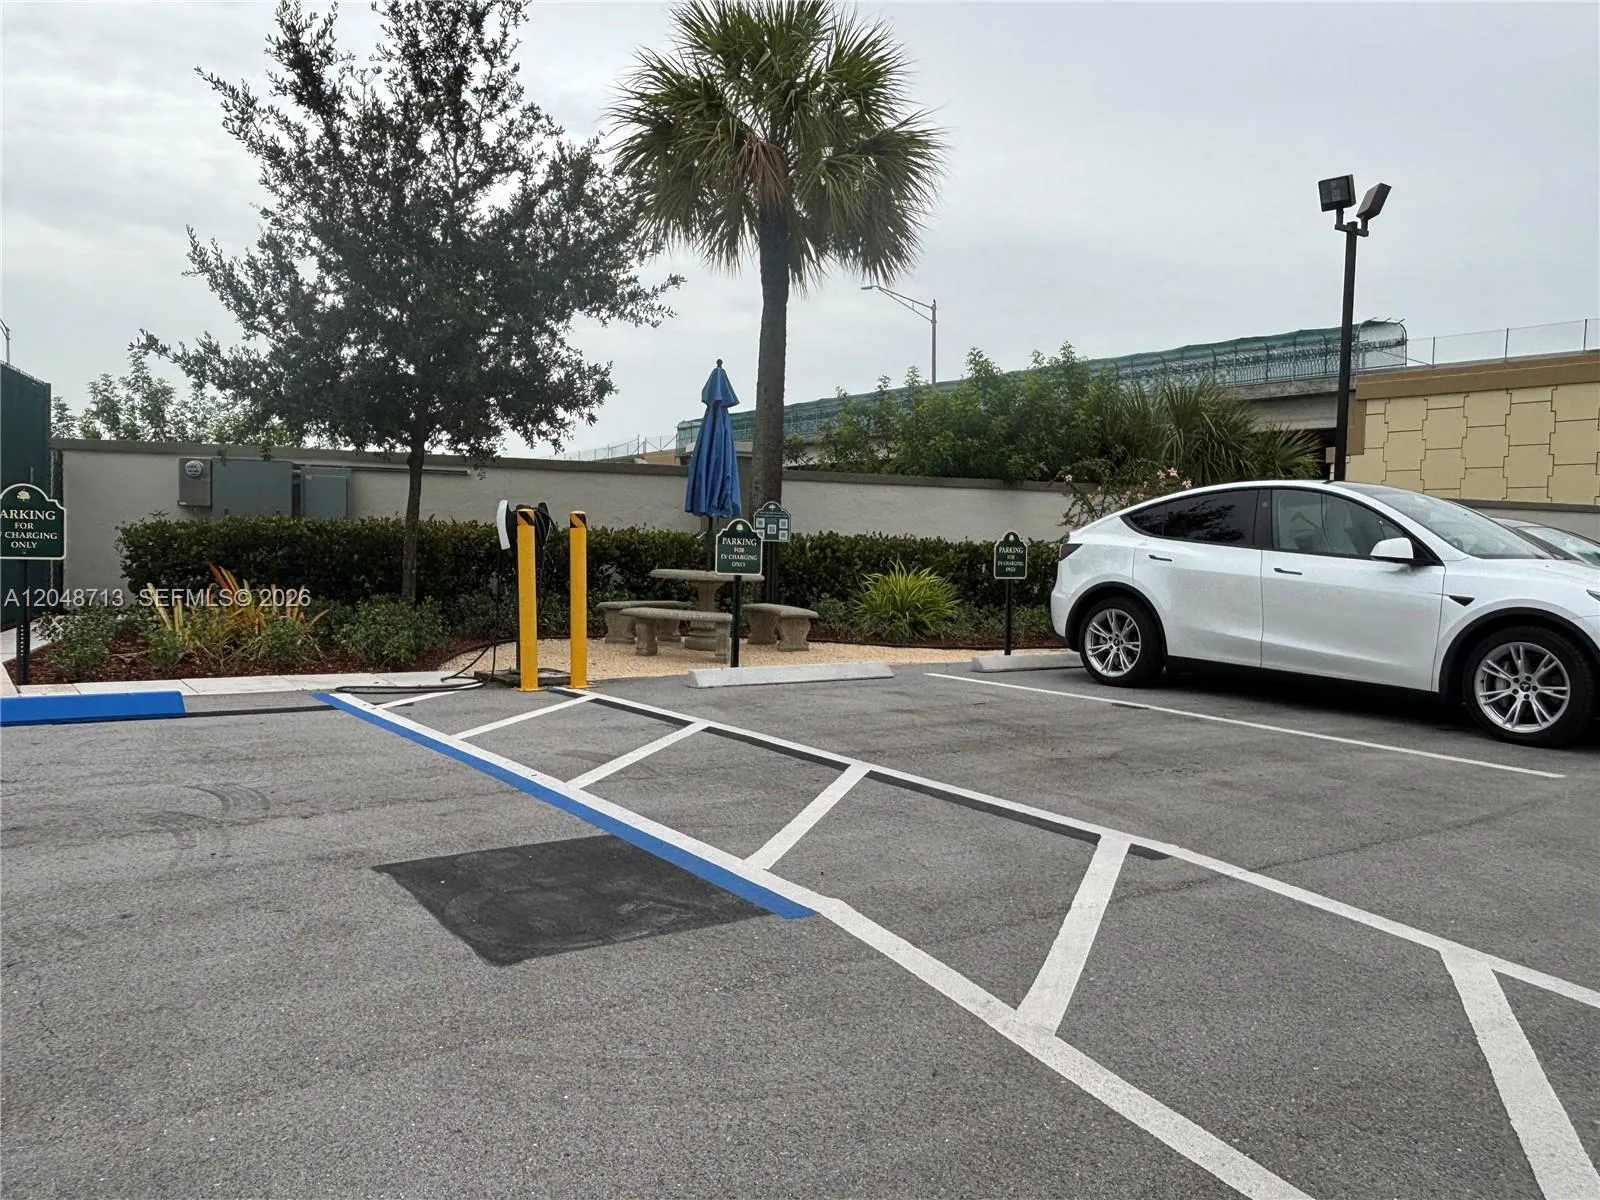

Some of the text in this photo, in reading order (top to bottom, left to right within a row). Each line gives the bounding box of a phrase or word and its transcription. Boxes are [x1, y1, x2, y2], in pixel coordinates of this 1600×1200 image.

[0, 509, 56, 520] ARKING
[14, 522, 34, 530] FOR
[4, 531, 58, 540] CHARGING
[10, 541, 38, 549] ONLY
[722, 537, 757, 546] PARKING
[998, 546, 1024, 554] PARKING
